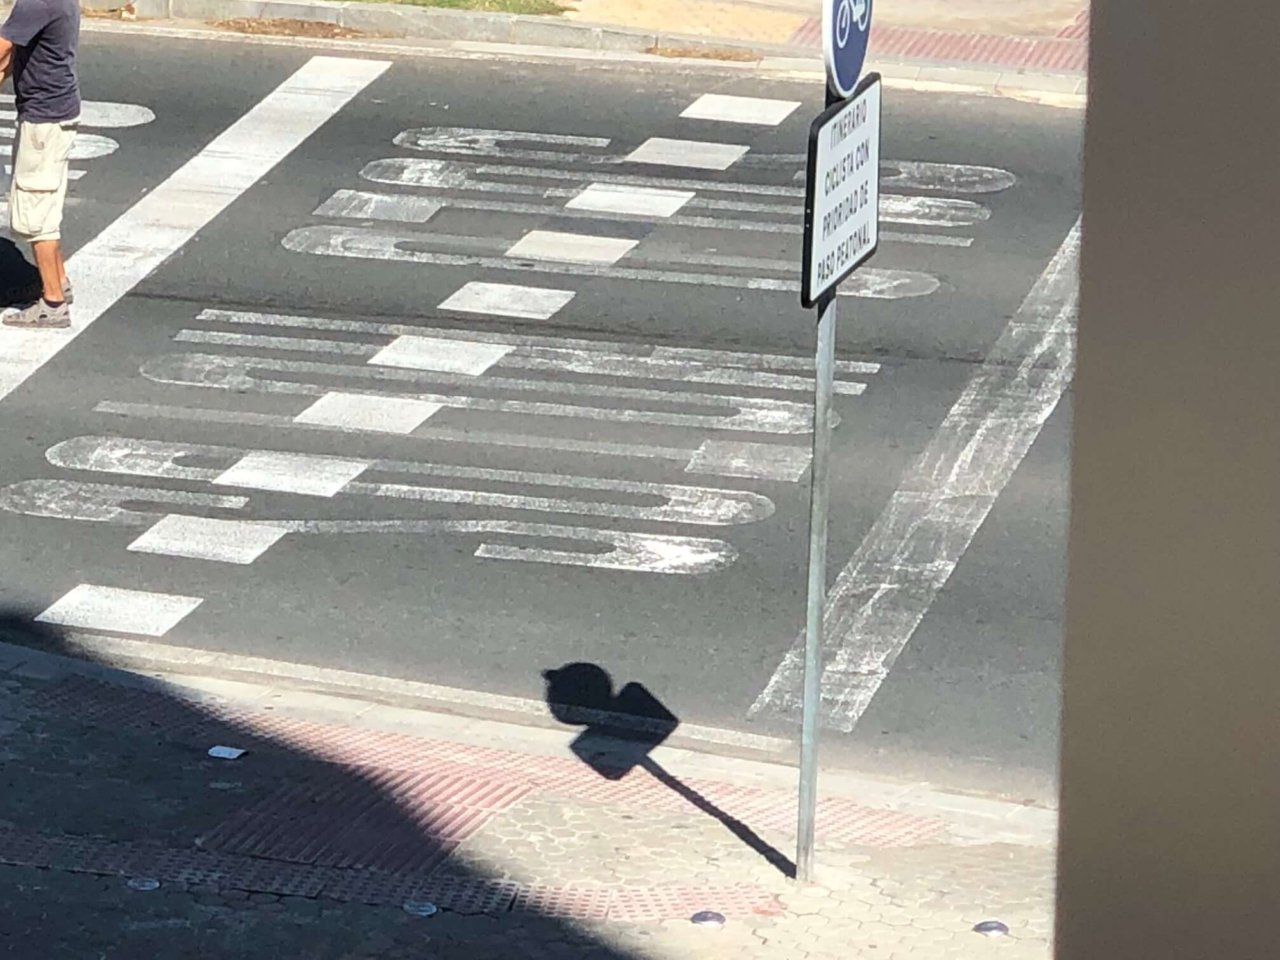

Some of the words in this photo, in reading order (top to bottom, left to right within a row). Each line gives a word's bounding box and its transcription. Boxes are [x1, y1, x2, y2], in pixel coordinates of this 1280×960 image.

[830, 98, 867, 150] ITINERARIO
[825, 151, 854, 196] CICLISTA
[856, 137, 870, 171] CON
[822, 189, 858, 241] PRIORIDAD
[860, 179, 868, 209] DE
[817, 251, 834, 288] PASO
[836, 221, 870, 271] PEATONAL
